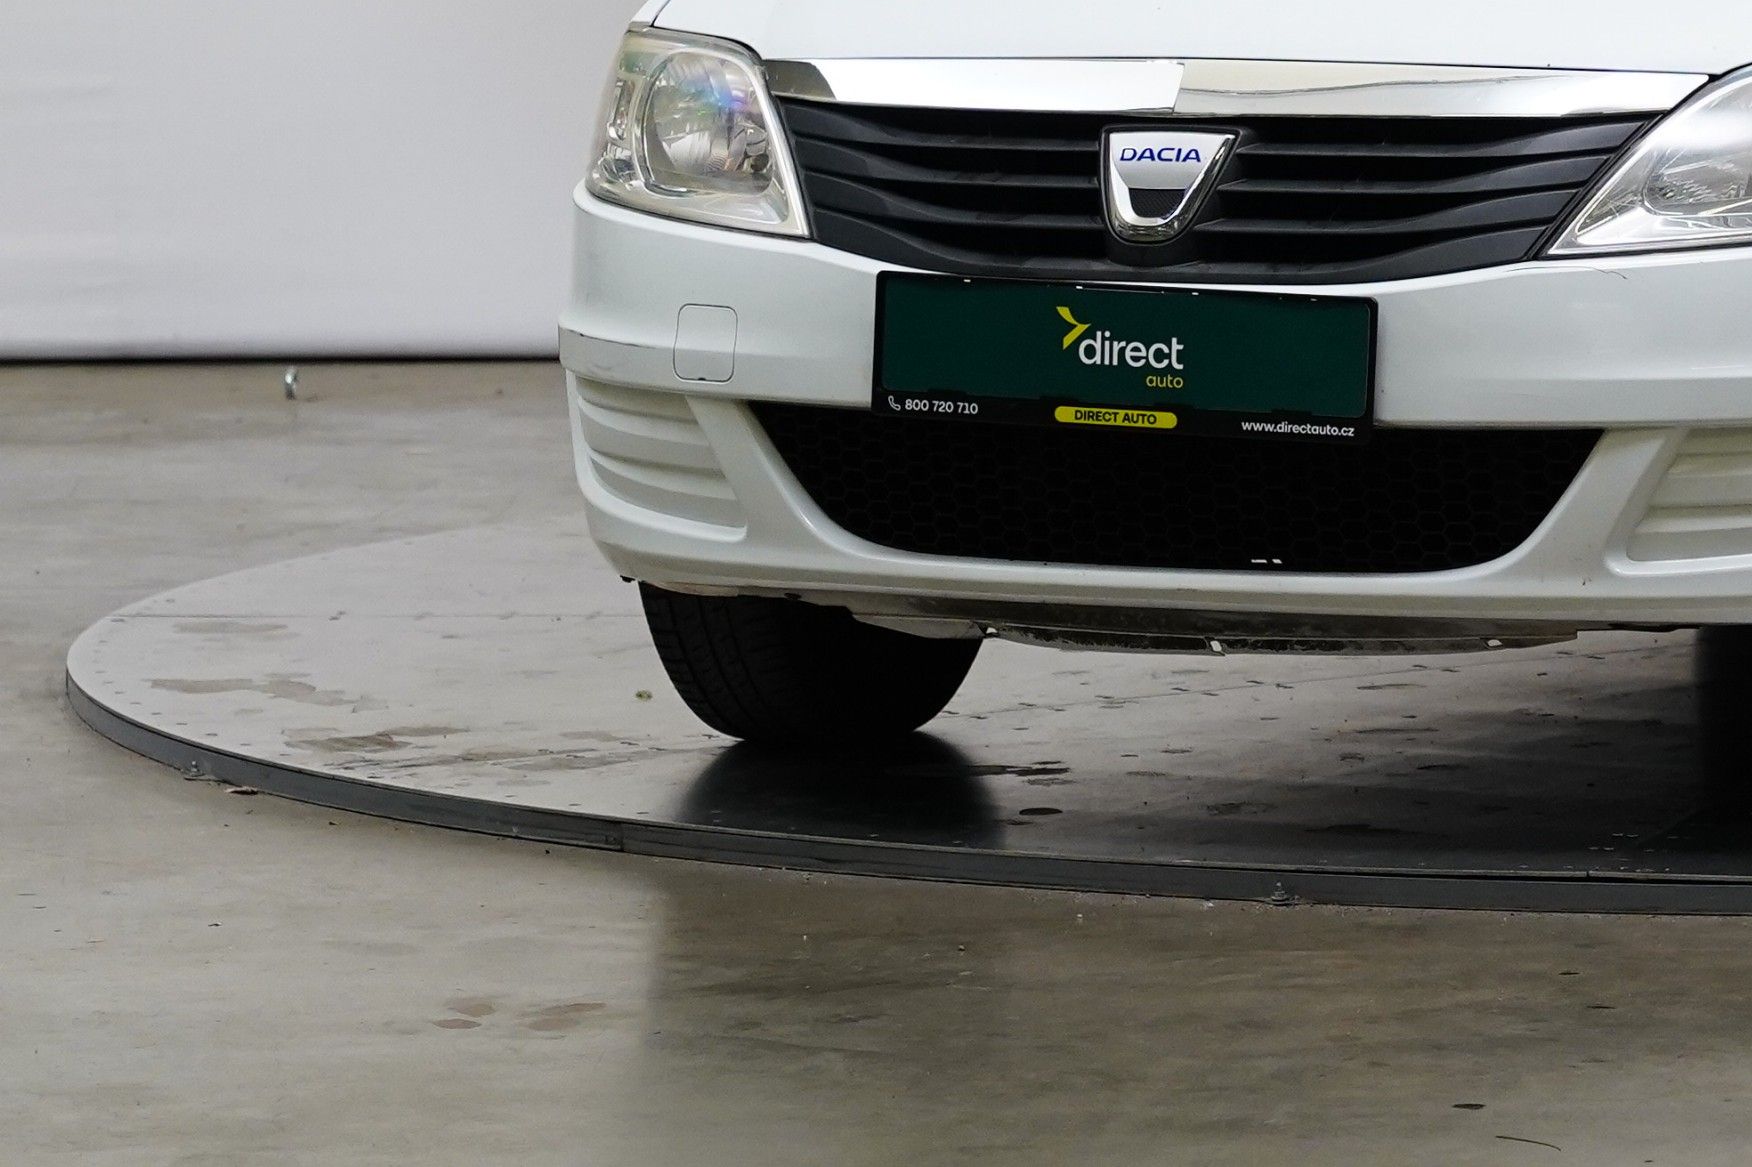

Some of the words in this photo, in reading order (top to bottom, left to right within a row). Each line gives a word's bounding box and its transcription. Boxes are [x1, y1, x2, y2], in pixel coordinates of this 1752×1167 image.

[1119, 147, 1202, 163] DACIA
[1078, 330, 1185, 370] direct
[1145, 374, 1184, 389] auto
[905, 398, 930, 412] 800
[931, 400, 954, 413] 720
[957, 402, 979, 415] 710
[1074, 410, 1119, 423] DIRECT
[1121, 413, 1158, 425] AUTO
[1241, 421, 1355, 437] www.directauto.cz
